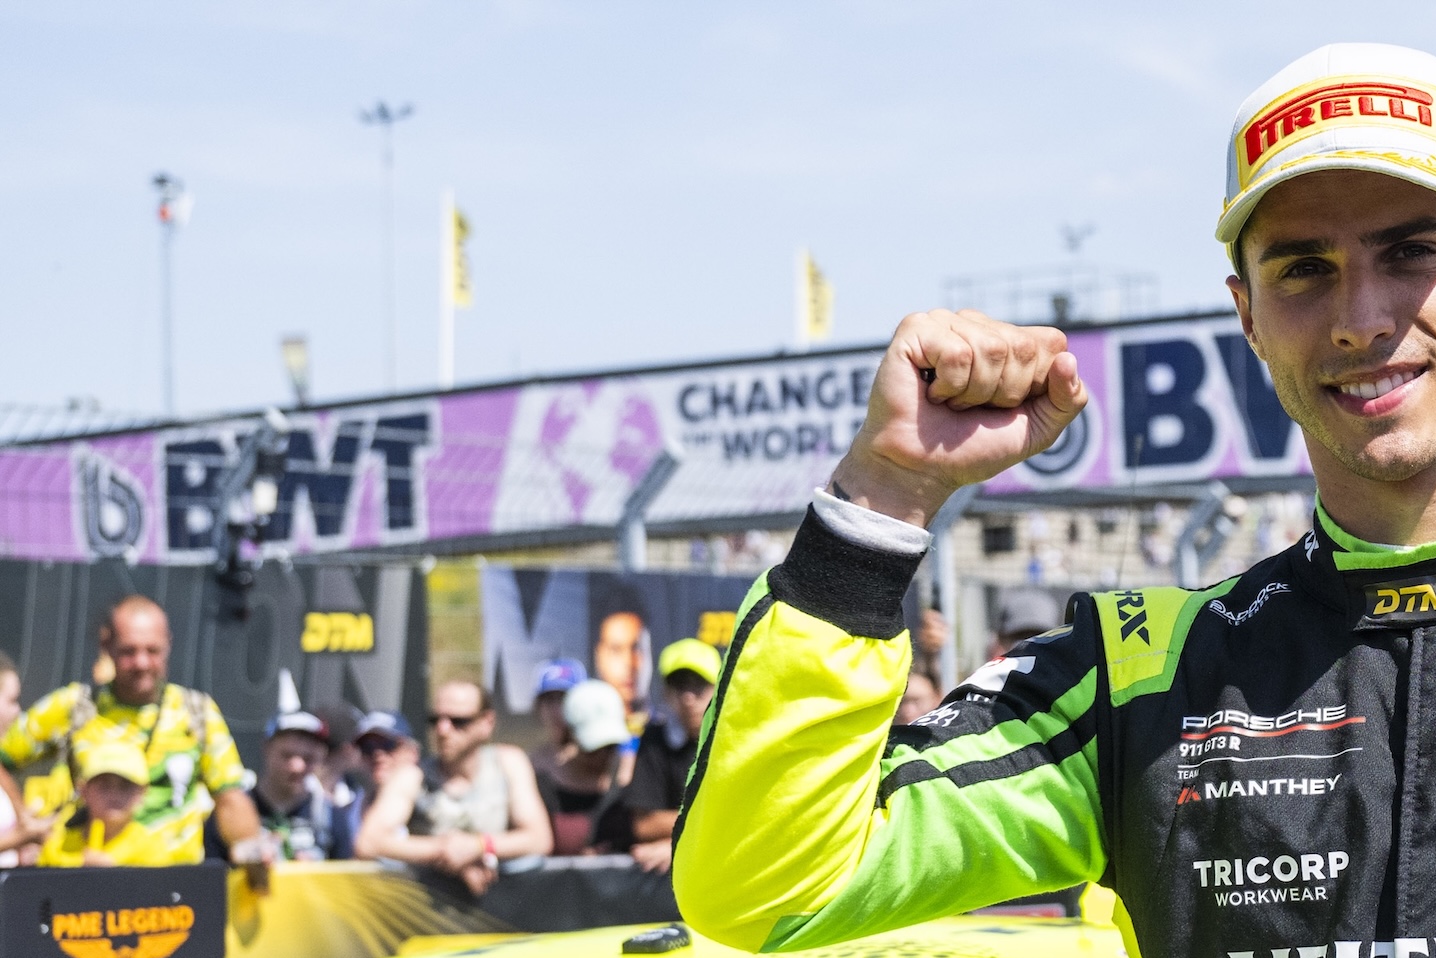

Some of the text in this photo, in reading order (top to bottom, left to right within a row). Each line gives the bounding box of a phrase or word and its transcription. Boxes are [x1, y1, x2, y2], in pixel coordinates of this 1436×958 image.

[1245, 82, 1434, 166] PIRELLI
[677, 367, 873, 423] CHANGE
[720, 419, 863, 462] WORL
[1209, 582, 1290, 622] PADDOCK
[301, 611, 374, 653] DTM
[1182, 704, 1347, 730] PORSCHE
[1179, 736, 1241, 757] 911 GT3 R
[1205, 773, 1342, 799] MANTHEY
[1193, 850, 1350, 888] TRICORP
[1215, 886, 1328, 907] WORKWEAR
[52, 904, 195, 941] PME LEGEND
